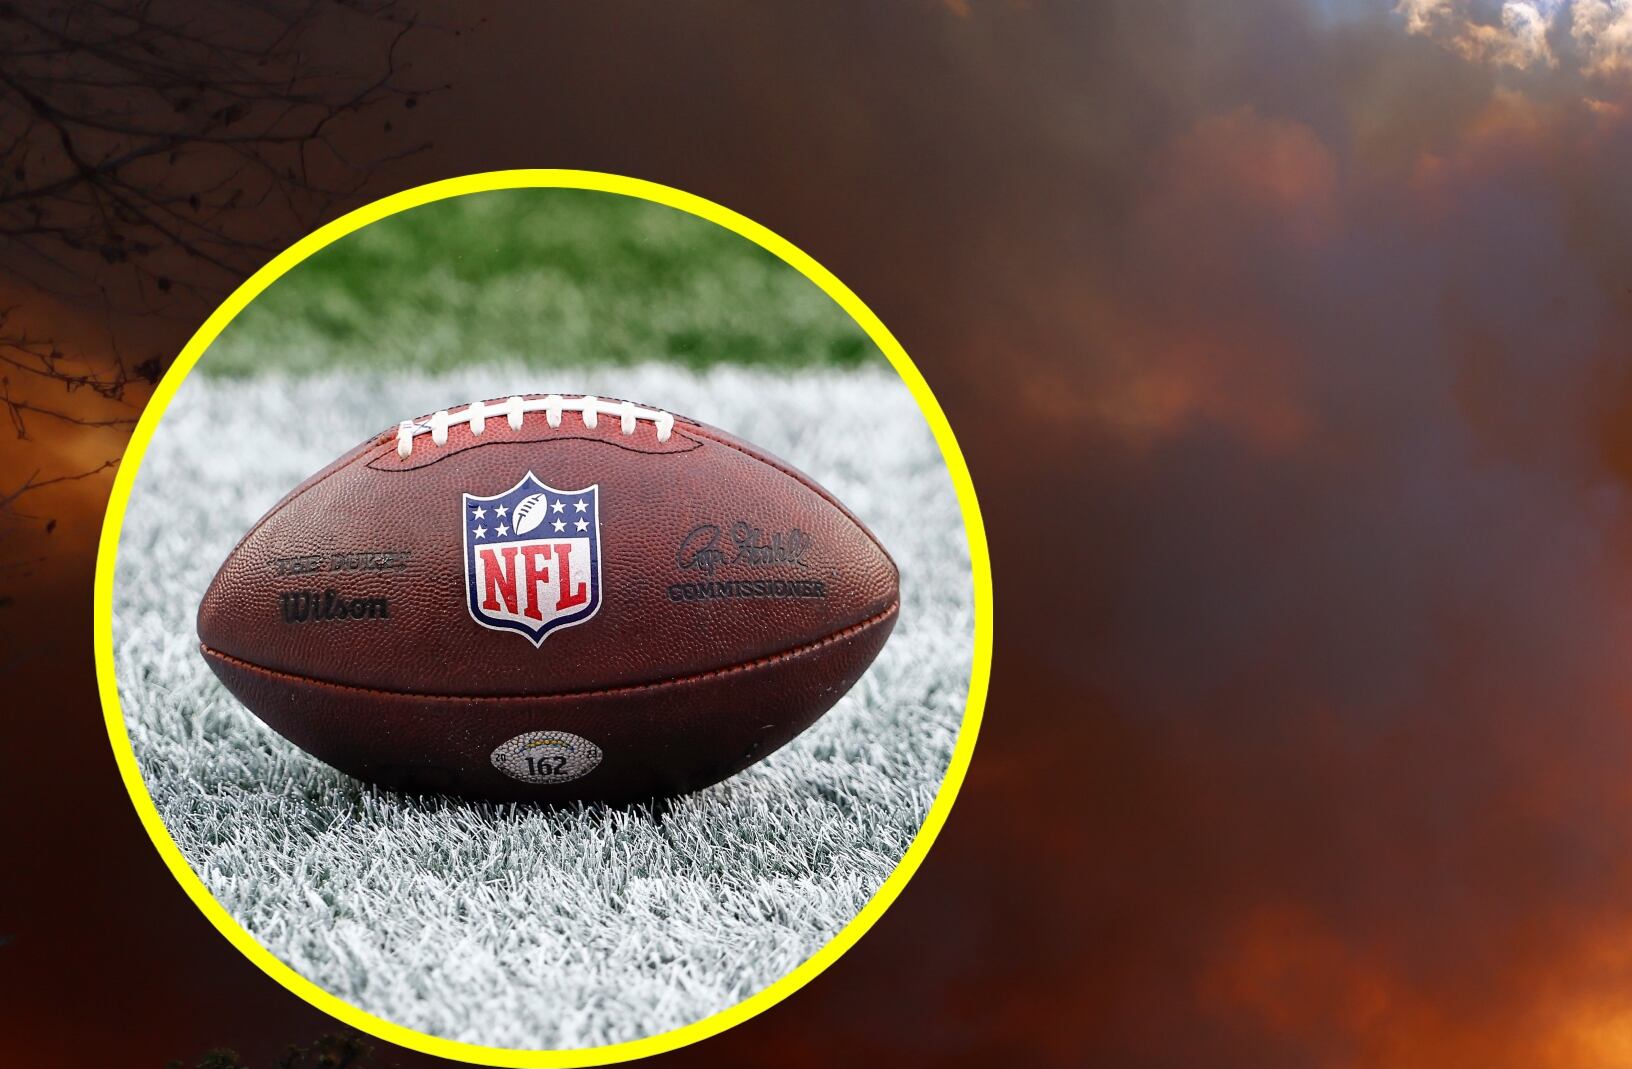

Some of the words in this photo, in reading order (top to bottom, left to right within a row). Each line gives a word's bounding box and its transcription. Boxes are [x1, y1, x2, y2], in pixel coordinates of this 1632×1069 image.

[480, 543, 587, 621] NFL
[668, 580, 827, 602] COMMISSIONER
[279, 588, 391, 625] Wilson
[525, 756, 569, 776] 162
